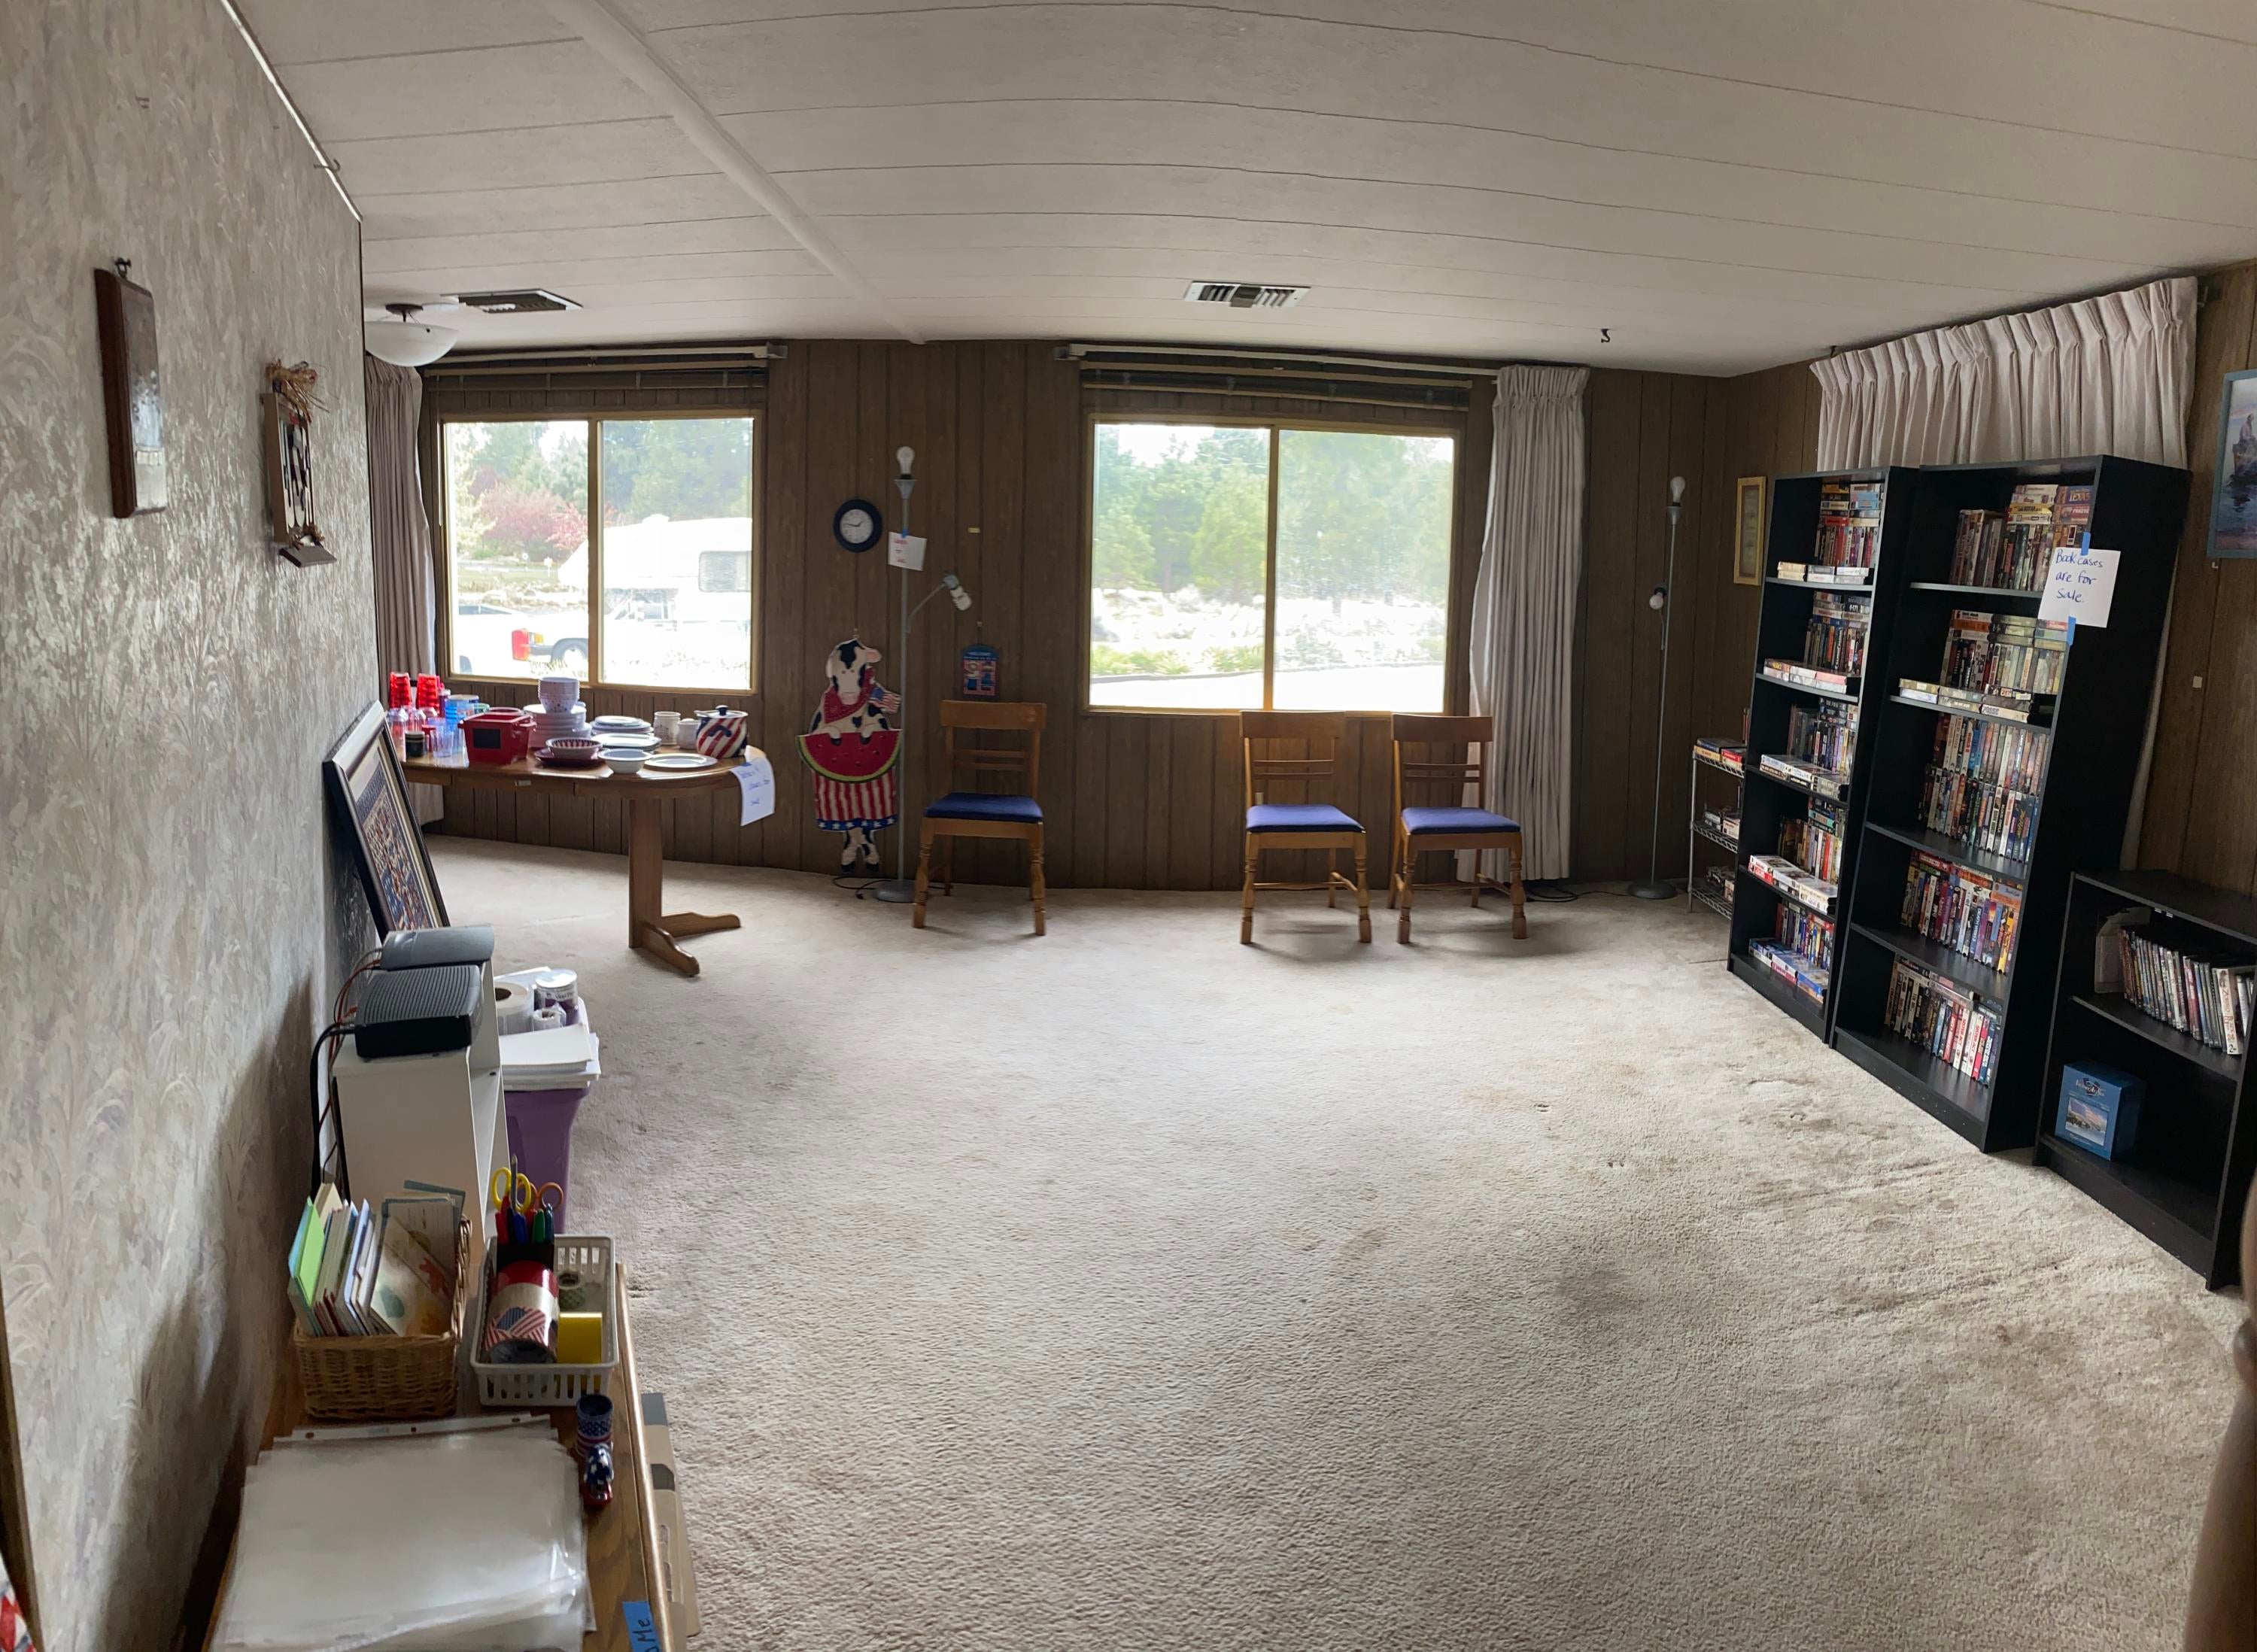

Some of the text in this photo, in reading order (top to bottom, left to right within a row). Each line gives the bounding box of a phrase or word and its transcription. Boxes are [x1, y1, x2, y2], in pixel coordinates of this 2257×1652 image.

[2055, 549, 2104, 568] Book cases
[2055, 571, 2098, 585] are for
